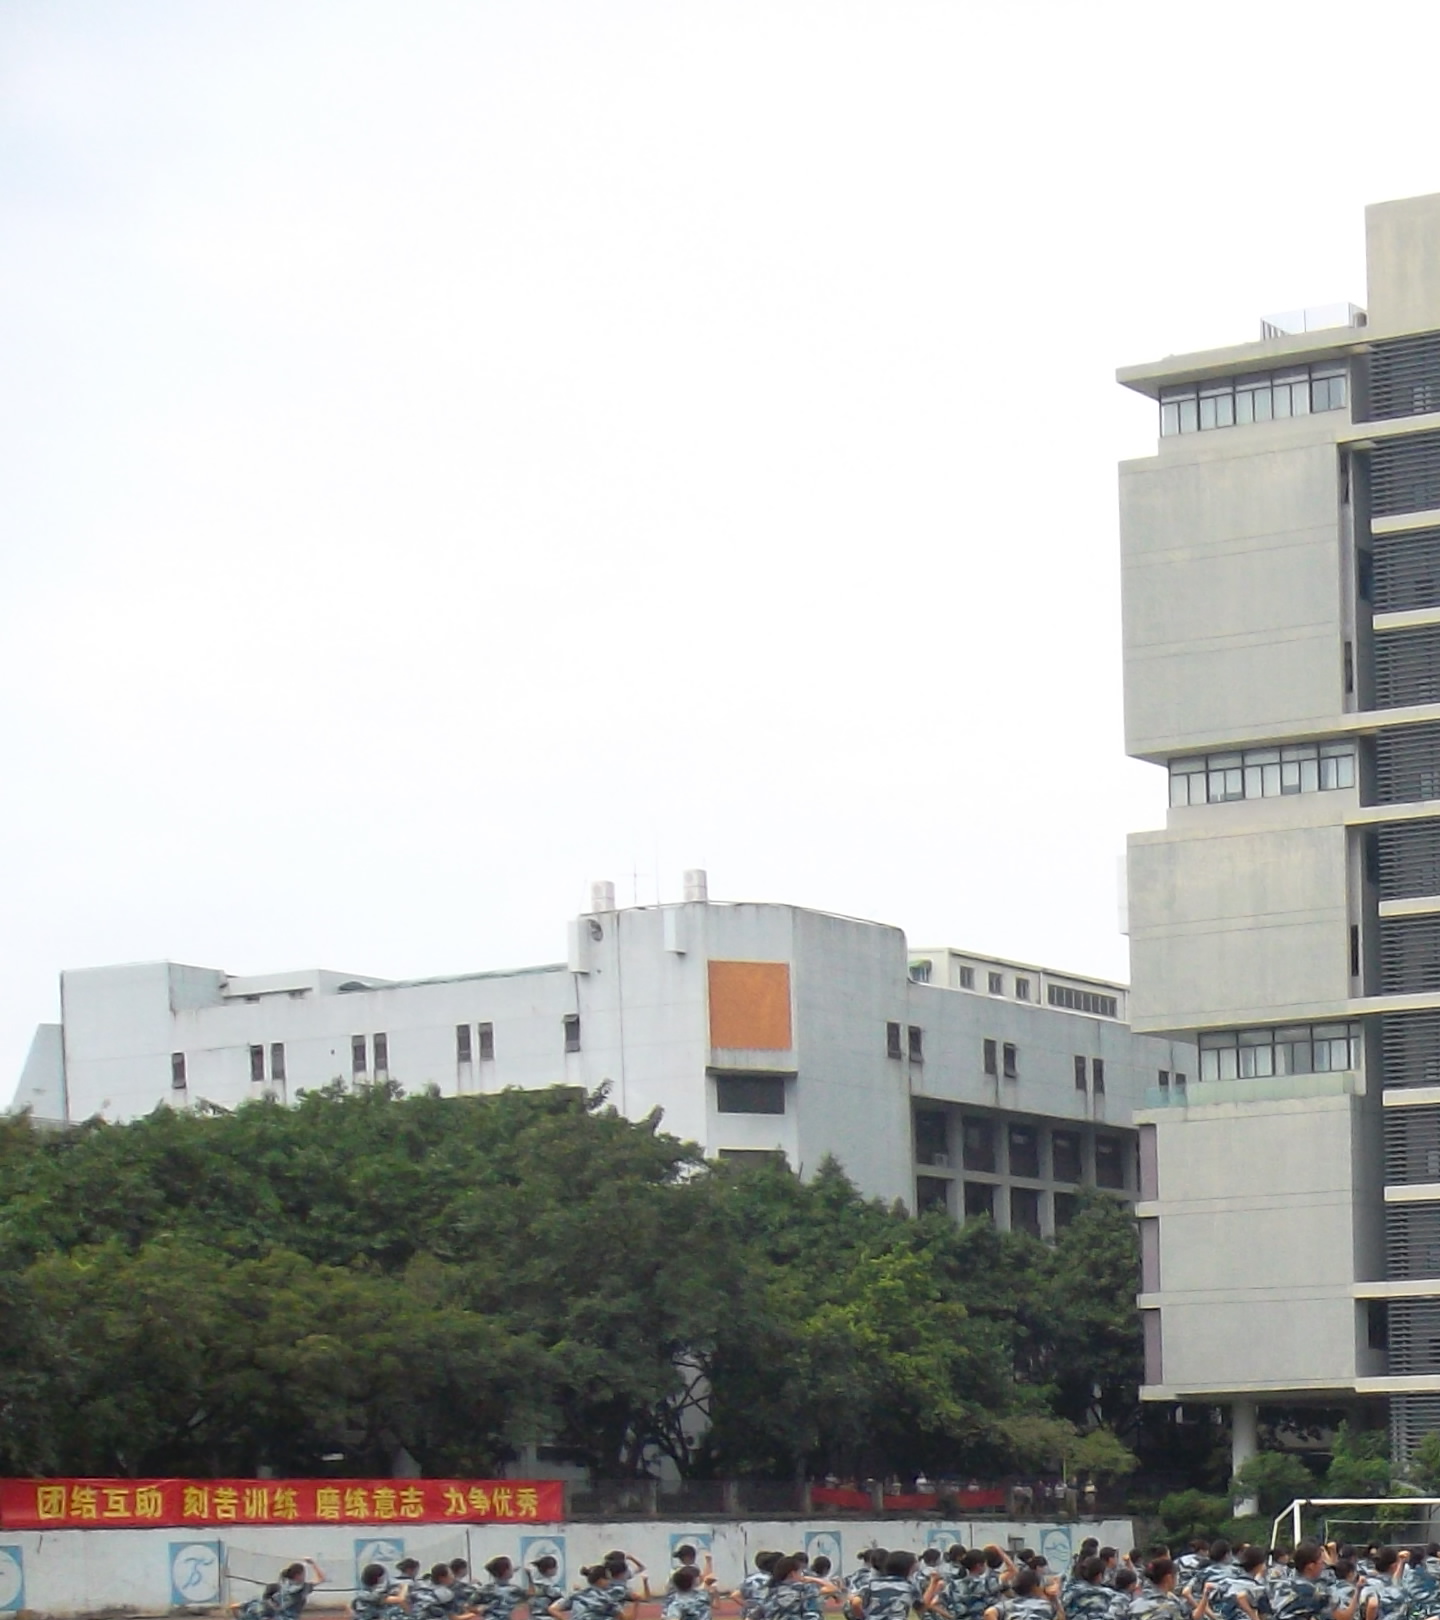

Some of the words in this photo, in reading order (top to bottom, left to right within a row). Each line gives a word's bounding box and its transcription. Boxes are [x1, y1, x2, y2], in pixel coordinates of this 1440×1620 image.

[36, 1485, 163, 1519] 团结互助
[183, 1486, 299, 1519] 刻苦训练
[315, 1487, 425, 1519] 磨练意志
[444, 1487, 539, 1518] 力争优秀
